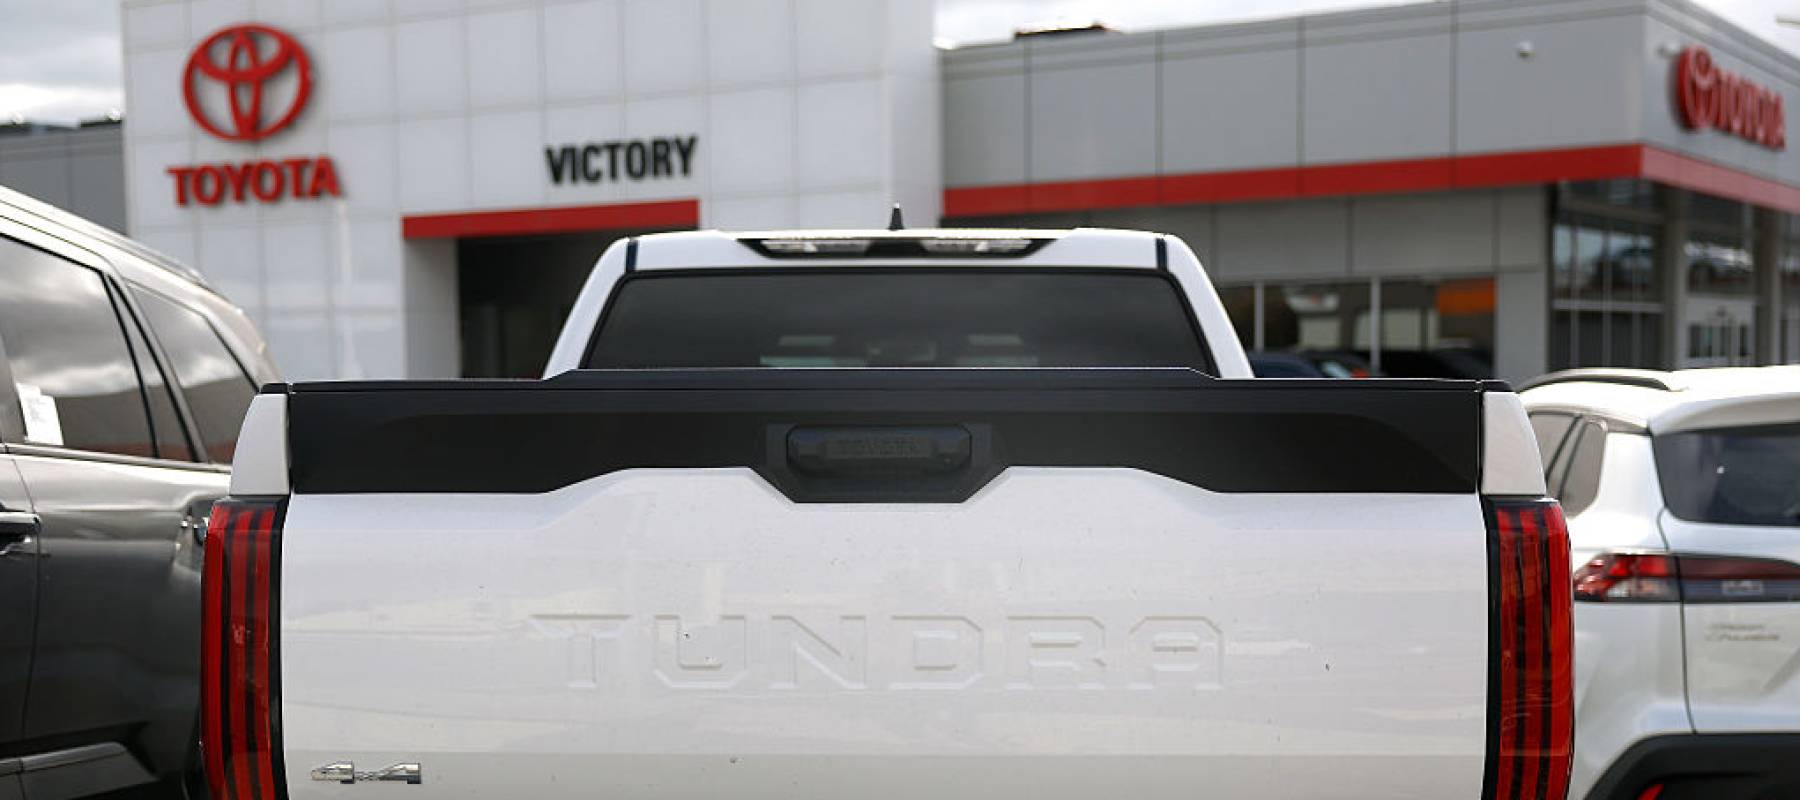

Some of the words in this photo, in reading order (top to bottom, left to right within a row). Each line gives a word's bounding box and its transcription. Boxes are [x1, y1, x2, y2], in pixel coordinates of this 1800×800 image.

[167, 156, 341, 206] TOYOTA
[545, 136, 697, 185] VICTORY
[529, 615, 1225, 690] TUNDRA
